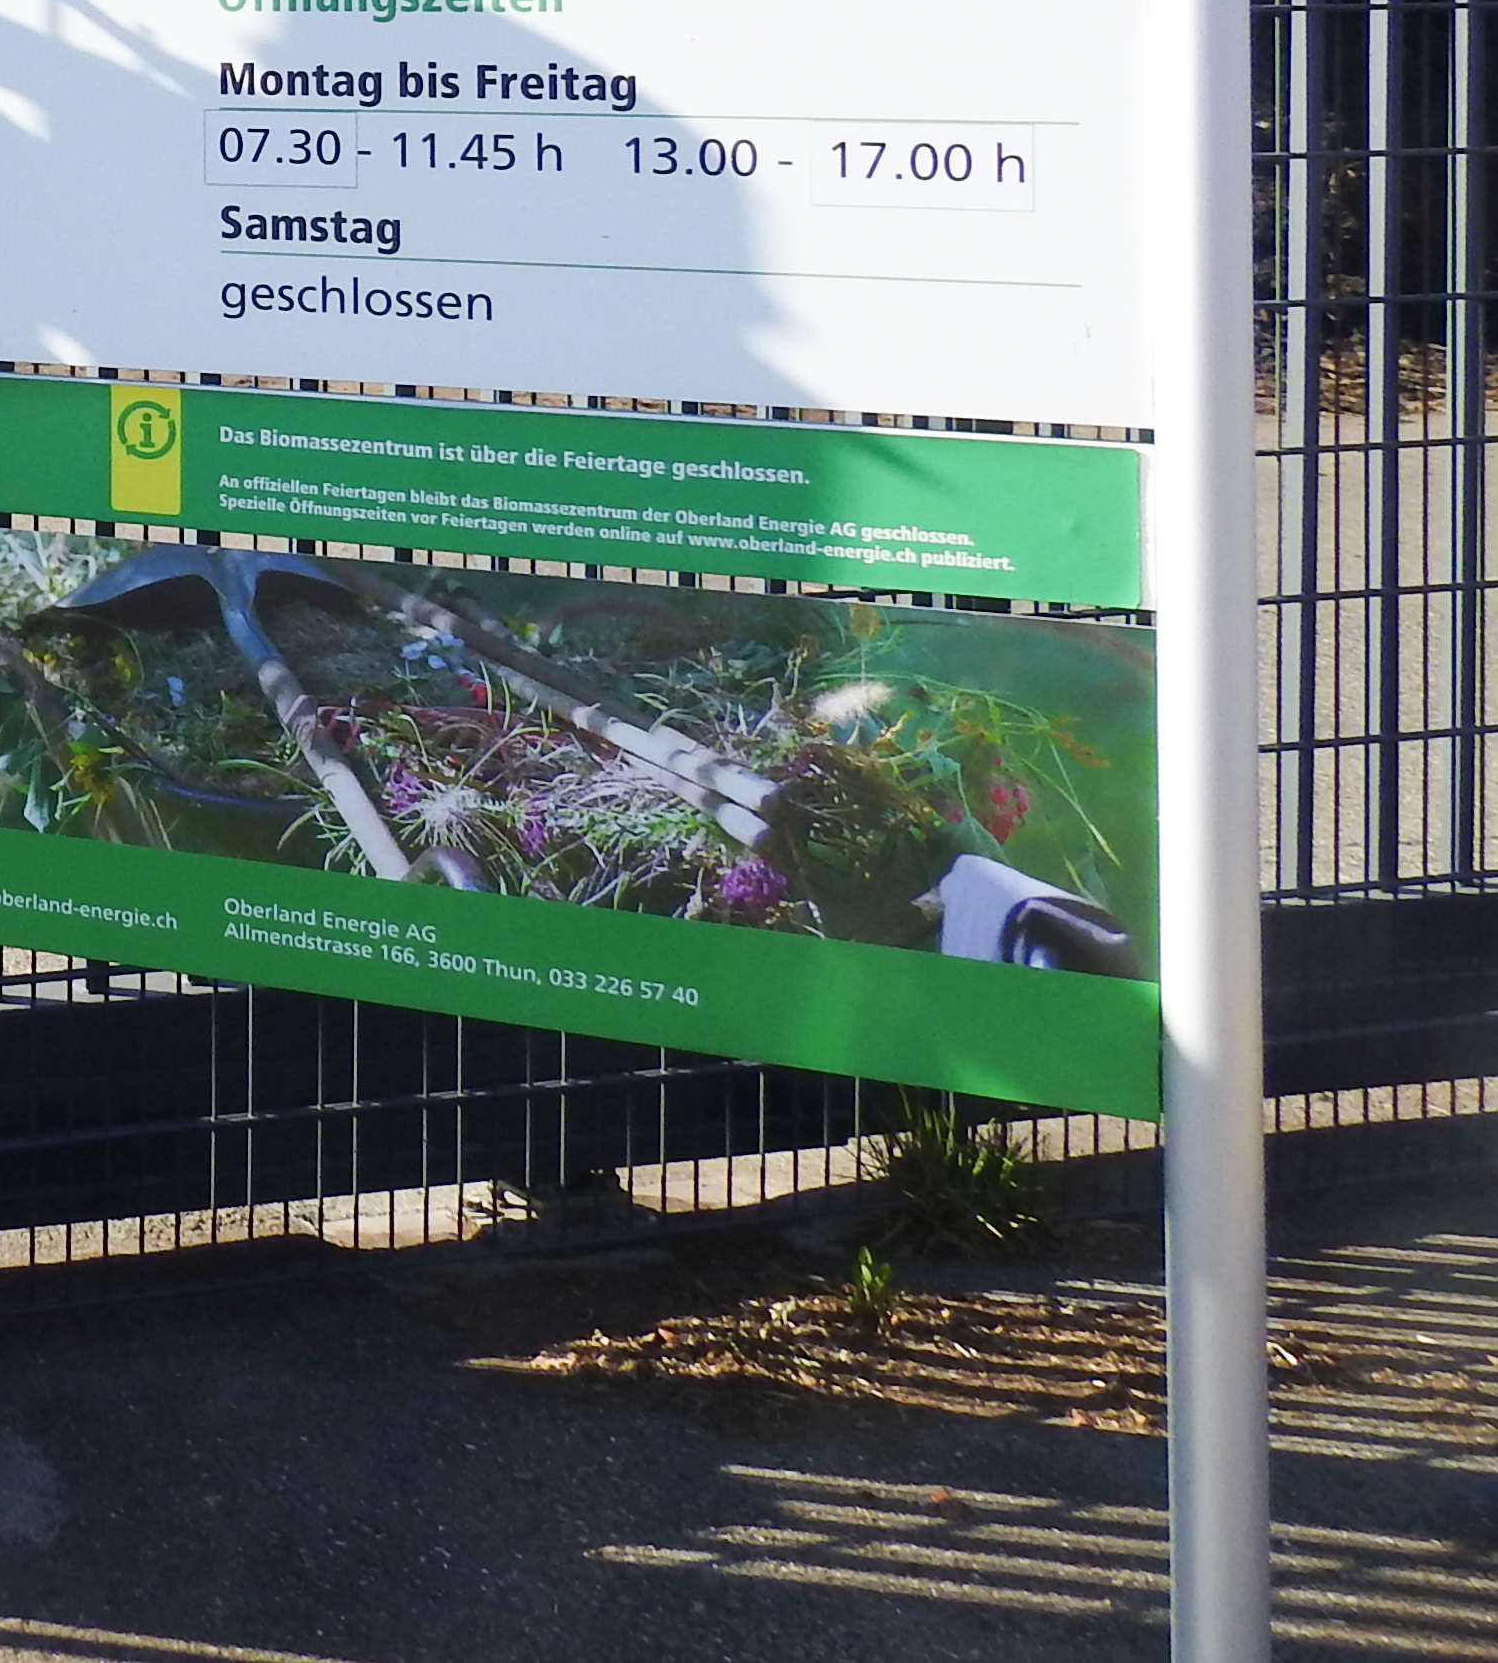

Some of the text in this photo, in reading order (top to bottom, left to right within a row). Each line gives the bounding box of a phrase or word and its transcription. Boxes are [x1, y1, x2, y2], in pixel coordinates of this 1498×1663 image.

[219, 61, 638, 111] Montag bis Freitag
[218, 126, 342, 165] 07.30
[392, 131, 517, 170] 11.45
[536, 132, 563, 172] h
[624, 136, 758, 177] 13.00
[830, 141, 973, 182] 17.00
[996, 142, 1026, 183] h
[220, 205, 402, 255] Samstag
[220, 275, 494, 321] geschlossen
[219, 425, 811, 485] Das Biomassezentrum ist über die Feiertage geschlossen.
[219, 474, 975, 547] An offiziellen Feiertagen bleibt das Biomassezentrum der Oberland Energie AG geschlossen.
[219, 493, 1016, 572] Spezielle Öffnungszeiten vor Feiertagen werden online auf www.oberland-energie.ch publiziert.
[223, 897, 437, 944] Oberland Energie AG
[223, 922, 699, 1006] Allmendstrasse 166, 3600 Thun, 033 226 57 40
